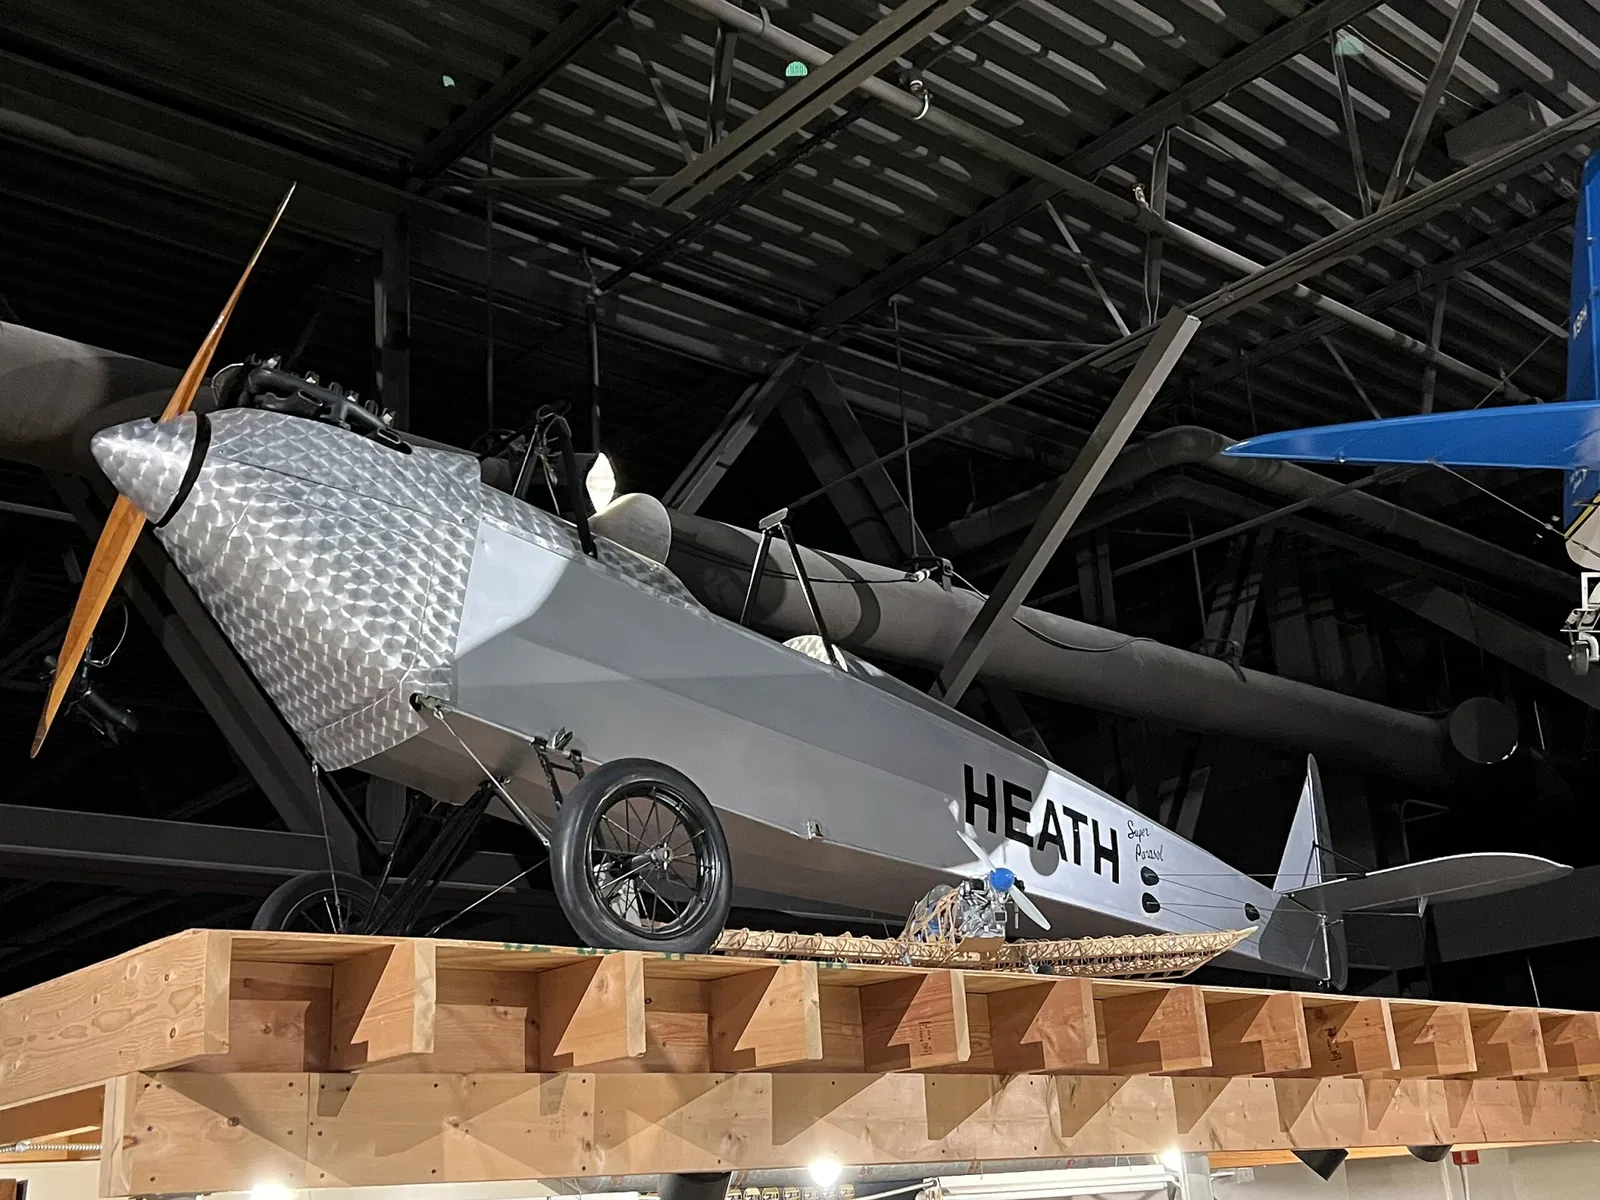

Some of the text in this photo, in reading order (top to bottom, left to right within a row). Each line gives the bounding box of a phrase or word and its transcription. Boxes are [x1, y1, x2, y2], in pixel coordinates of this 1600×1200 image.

[964, 763, 1119, 884] HEATH
[1127, 819, 1150, 843] Super
[1135, 843, 1164, 862] Parasol
